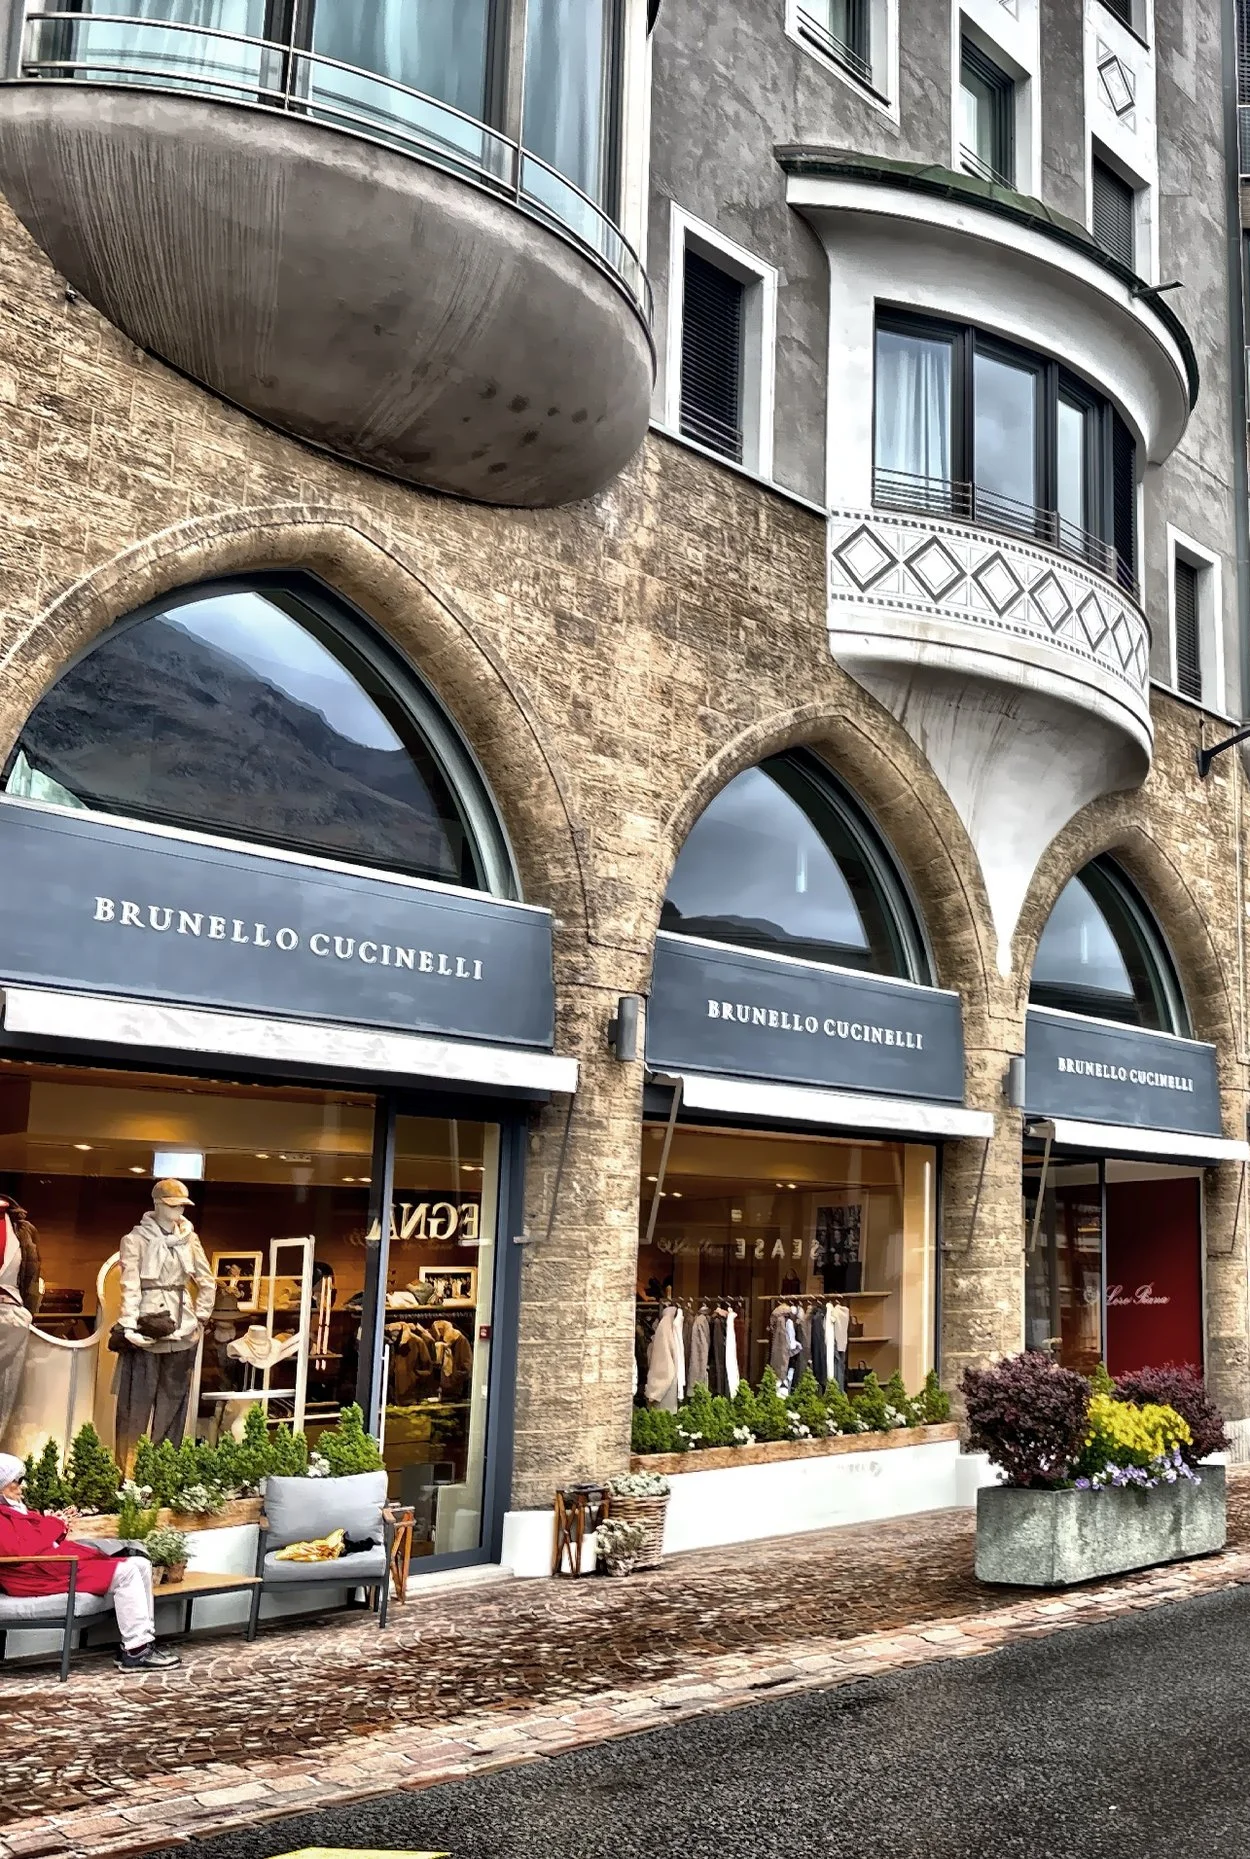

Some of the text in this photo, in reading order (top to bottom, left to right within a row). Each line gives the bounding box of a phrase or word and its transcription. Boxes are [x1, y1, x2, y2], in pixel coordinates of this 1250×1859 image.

[93, 896, 483, 980] BRUNELLO CUCINELLI
[707, 1000, 923, 1050] BRUNELLO CUCINELLI
[1057, 1057, 1194, 1092] BRUNELLO CUCINELLI
